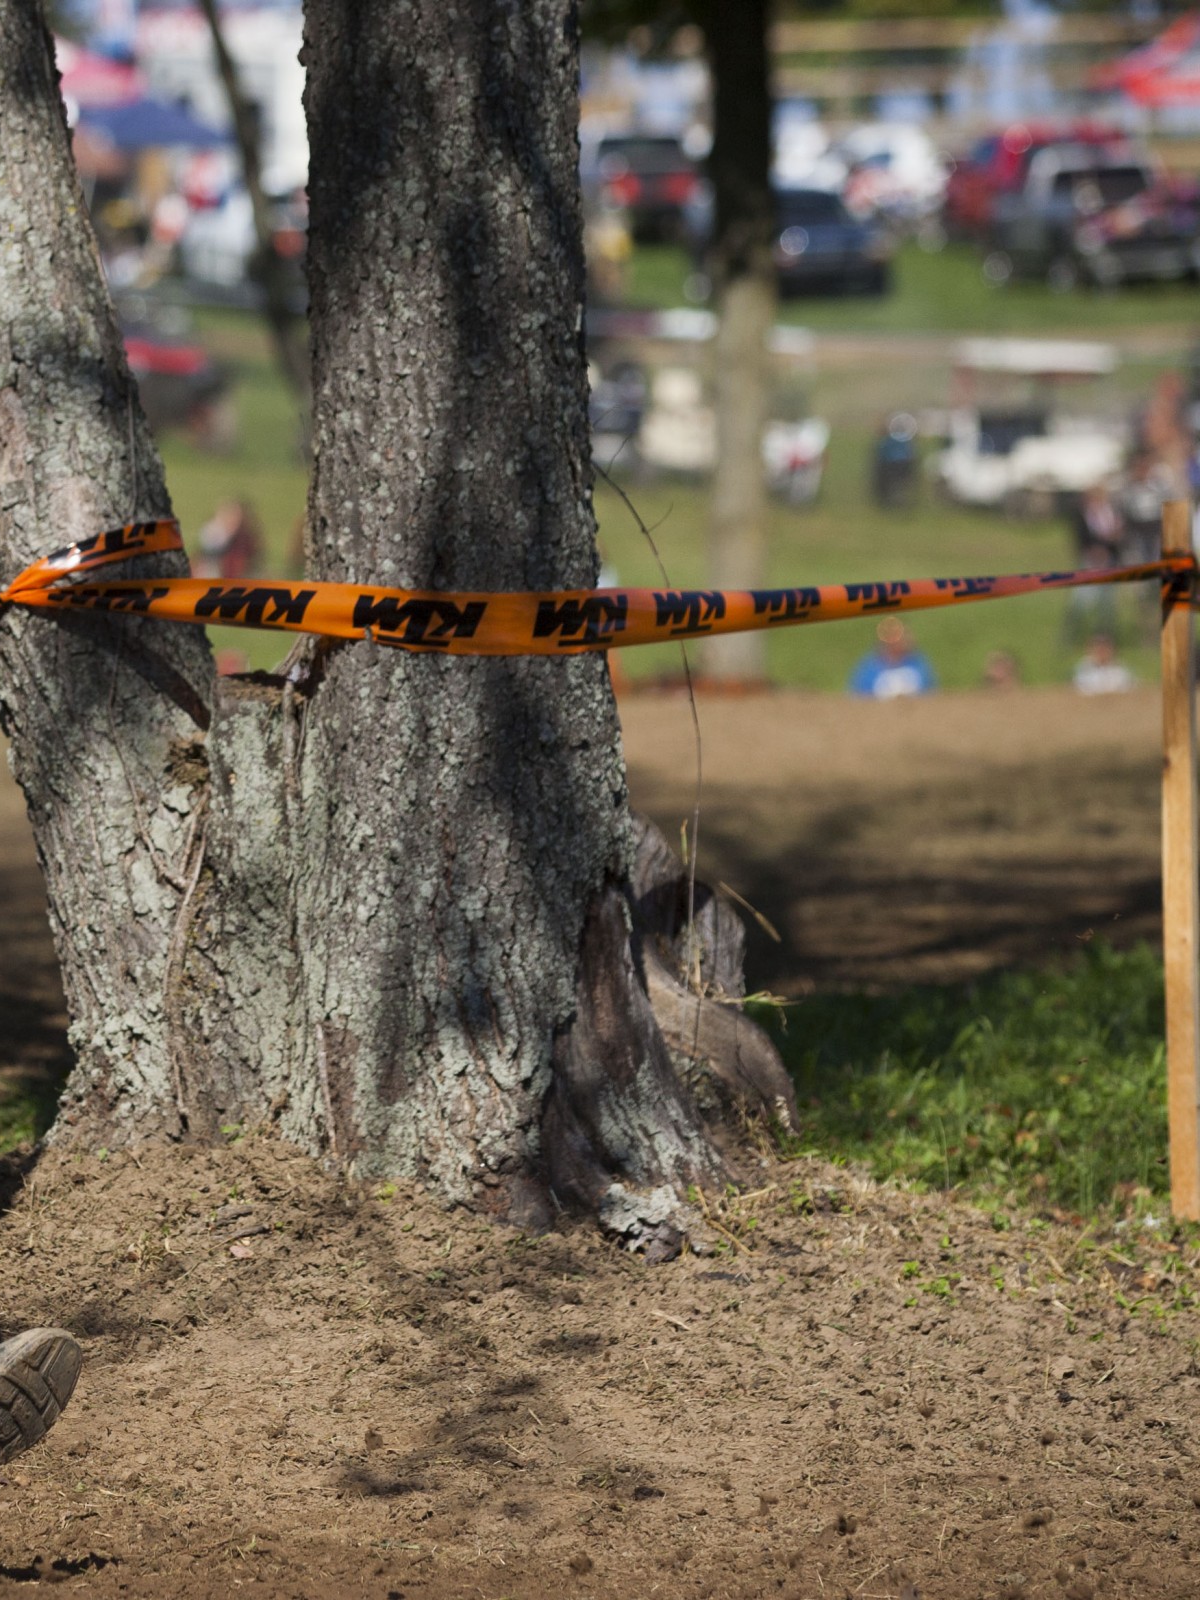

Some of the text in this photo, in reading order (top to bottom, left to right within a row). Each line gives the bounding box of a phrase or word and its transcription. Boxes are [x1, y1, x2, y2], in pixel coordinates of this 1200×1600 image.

[195, 586, 317, 629] KTM
[353, 595, 487, 647] KTM
[532, 593, 628, 647] KTM
[653, 591, 726, 634] KTM
